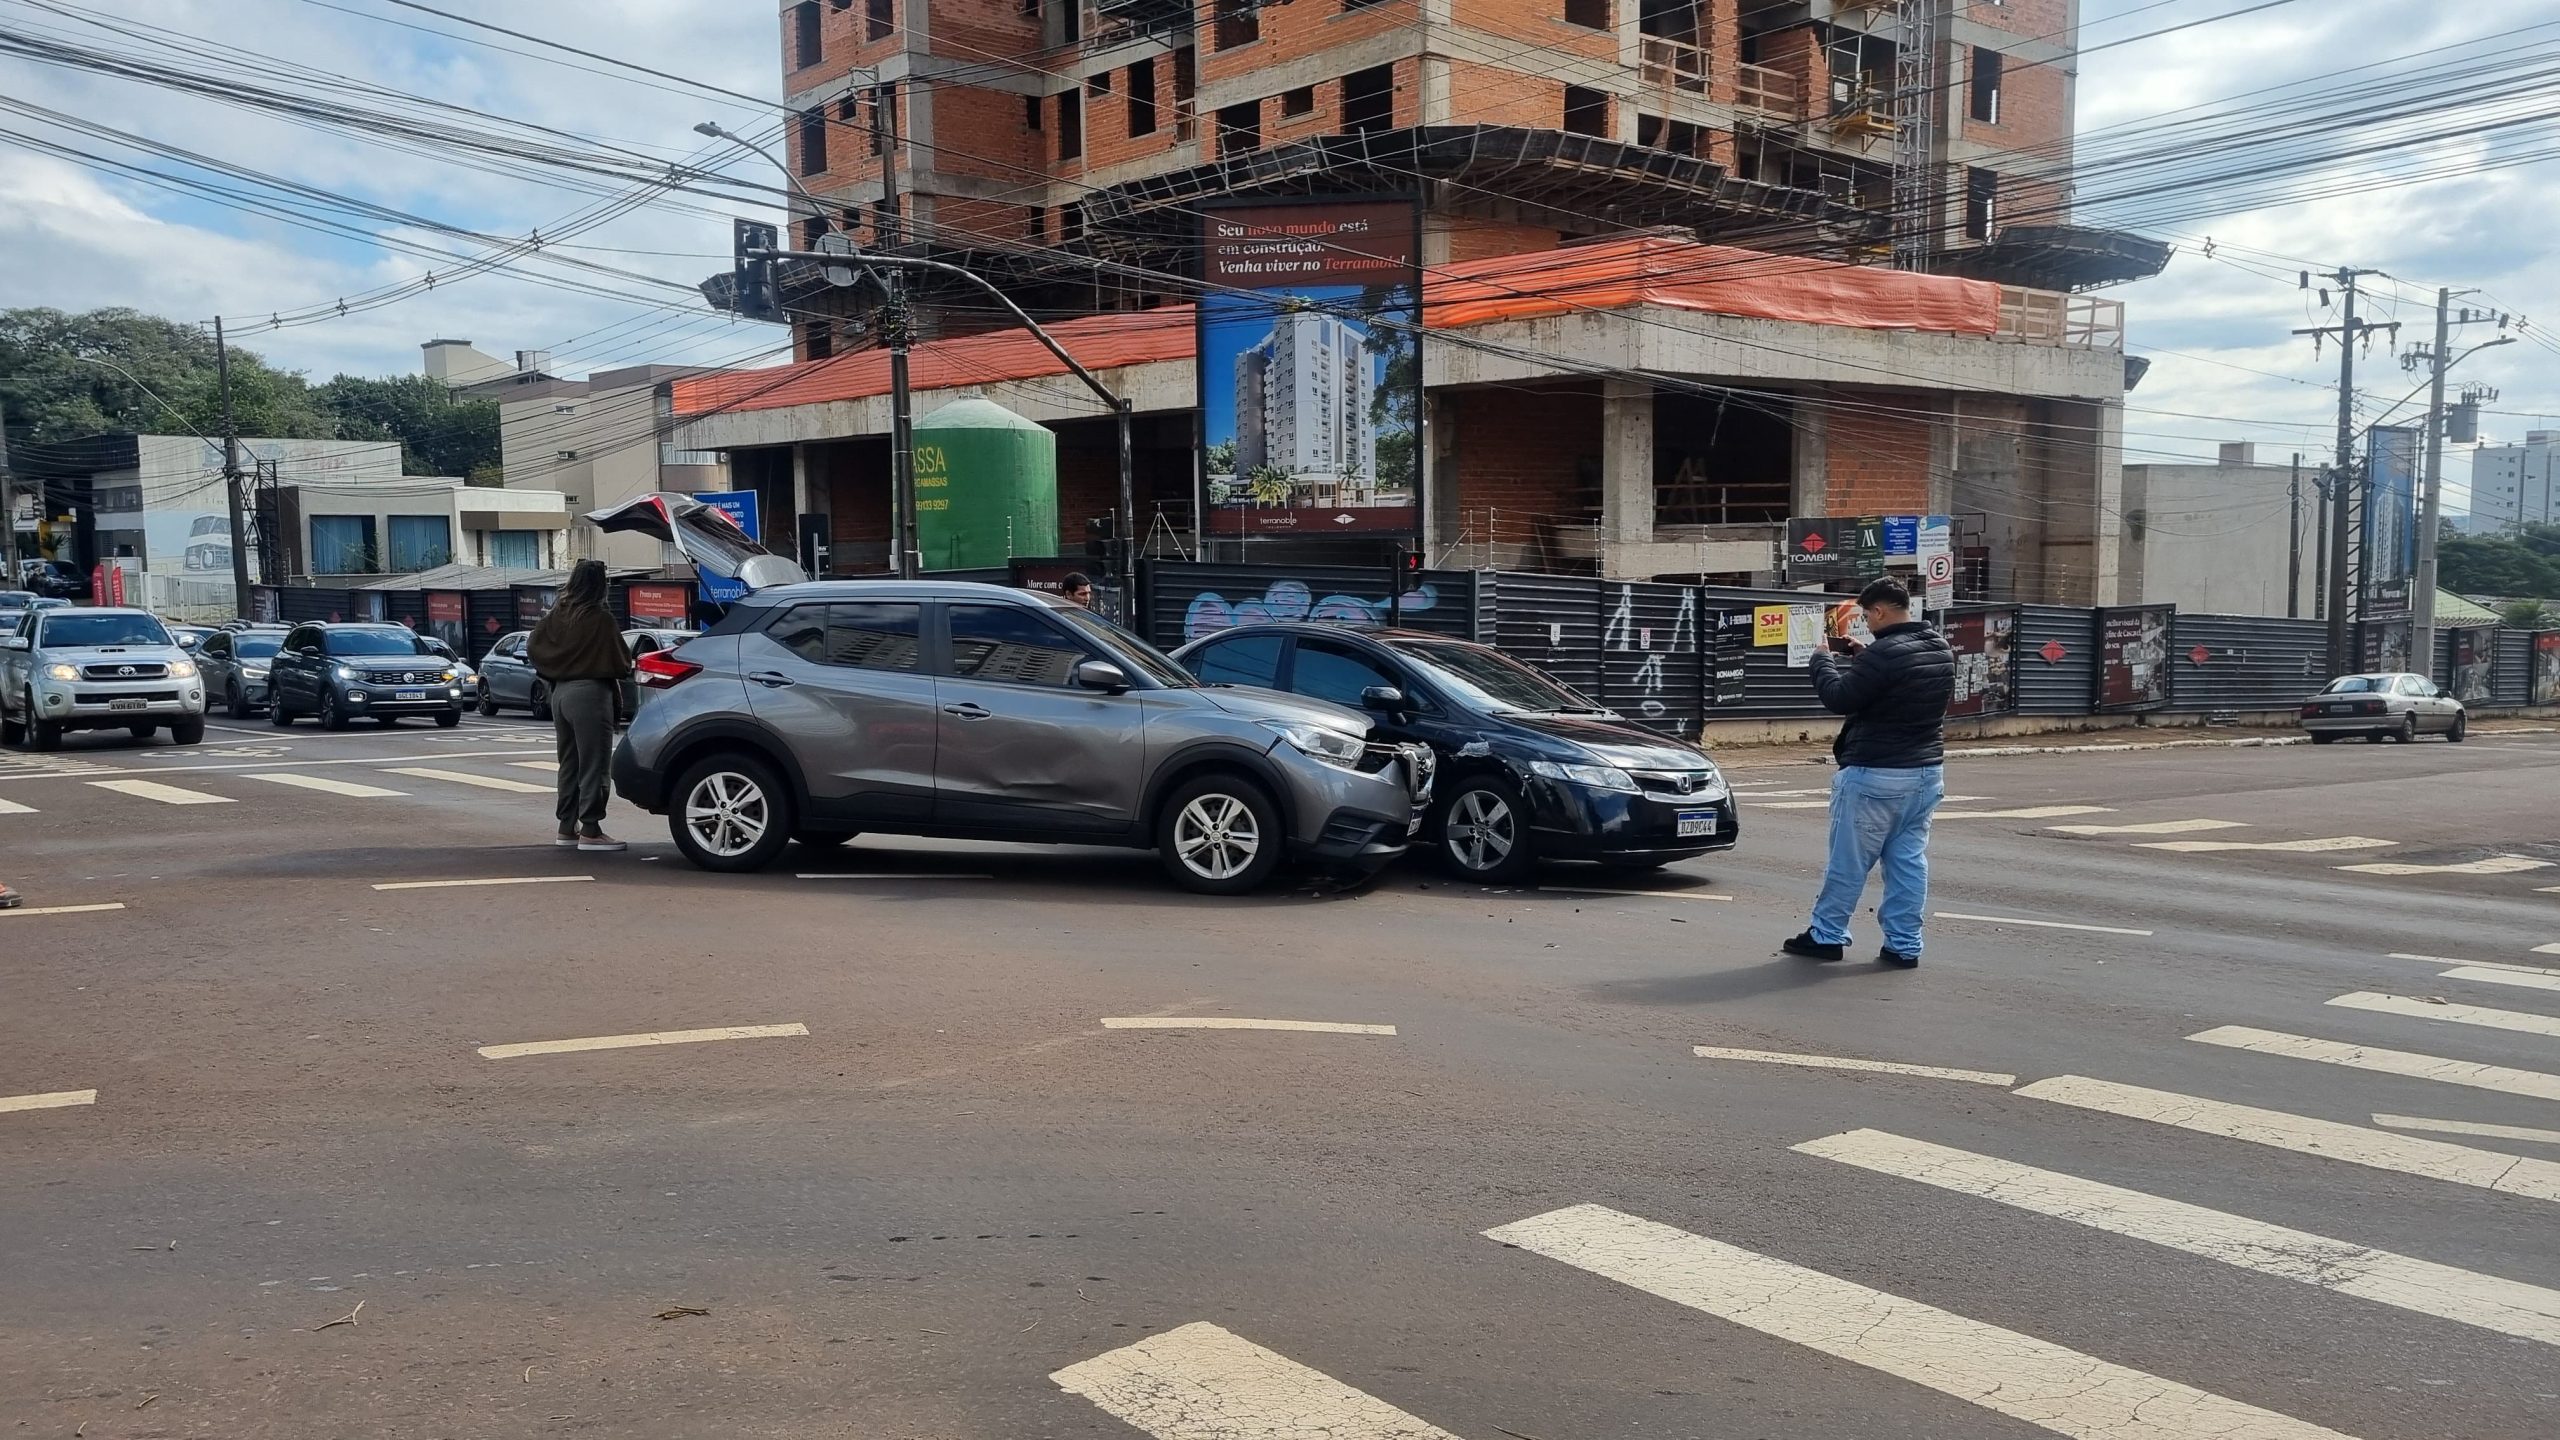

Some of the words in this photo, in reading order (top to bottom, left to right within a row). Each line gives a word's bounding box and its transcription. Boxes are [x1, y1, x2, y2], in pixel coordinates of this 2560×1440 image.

[1217, 224, 1243, 237] Seu
[1247, 226, 1282, 236] novo
[1286, 221, 1335, 234] mundo
[1339, 218, 1368, 232] está
[1218, 245, 1239, 255] em
[1219, 260, 1262, 274] Venha
[1266, 259, 1300, 272] viver
[1302, 261, 1321, 271] no
[1260, 511, 1297, 525] terranoble
[1790, 553, 1838, 563] TOMBINI
[1935, 562, 1944, 576] E
[1760, 613, 1783, 627] SH
[1716, 668, 1744, 678] BONAMIGO
